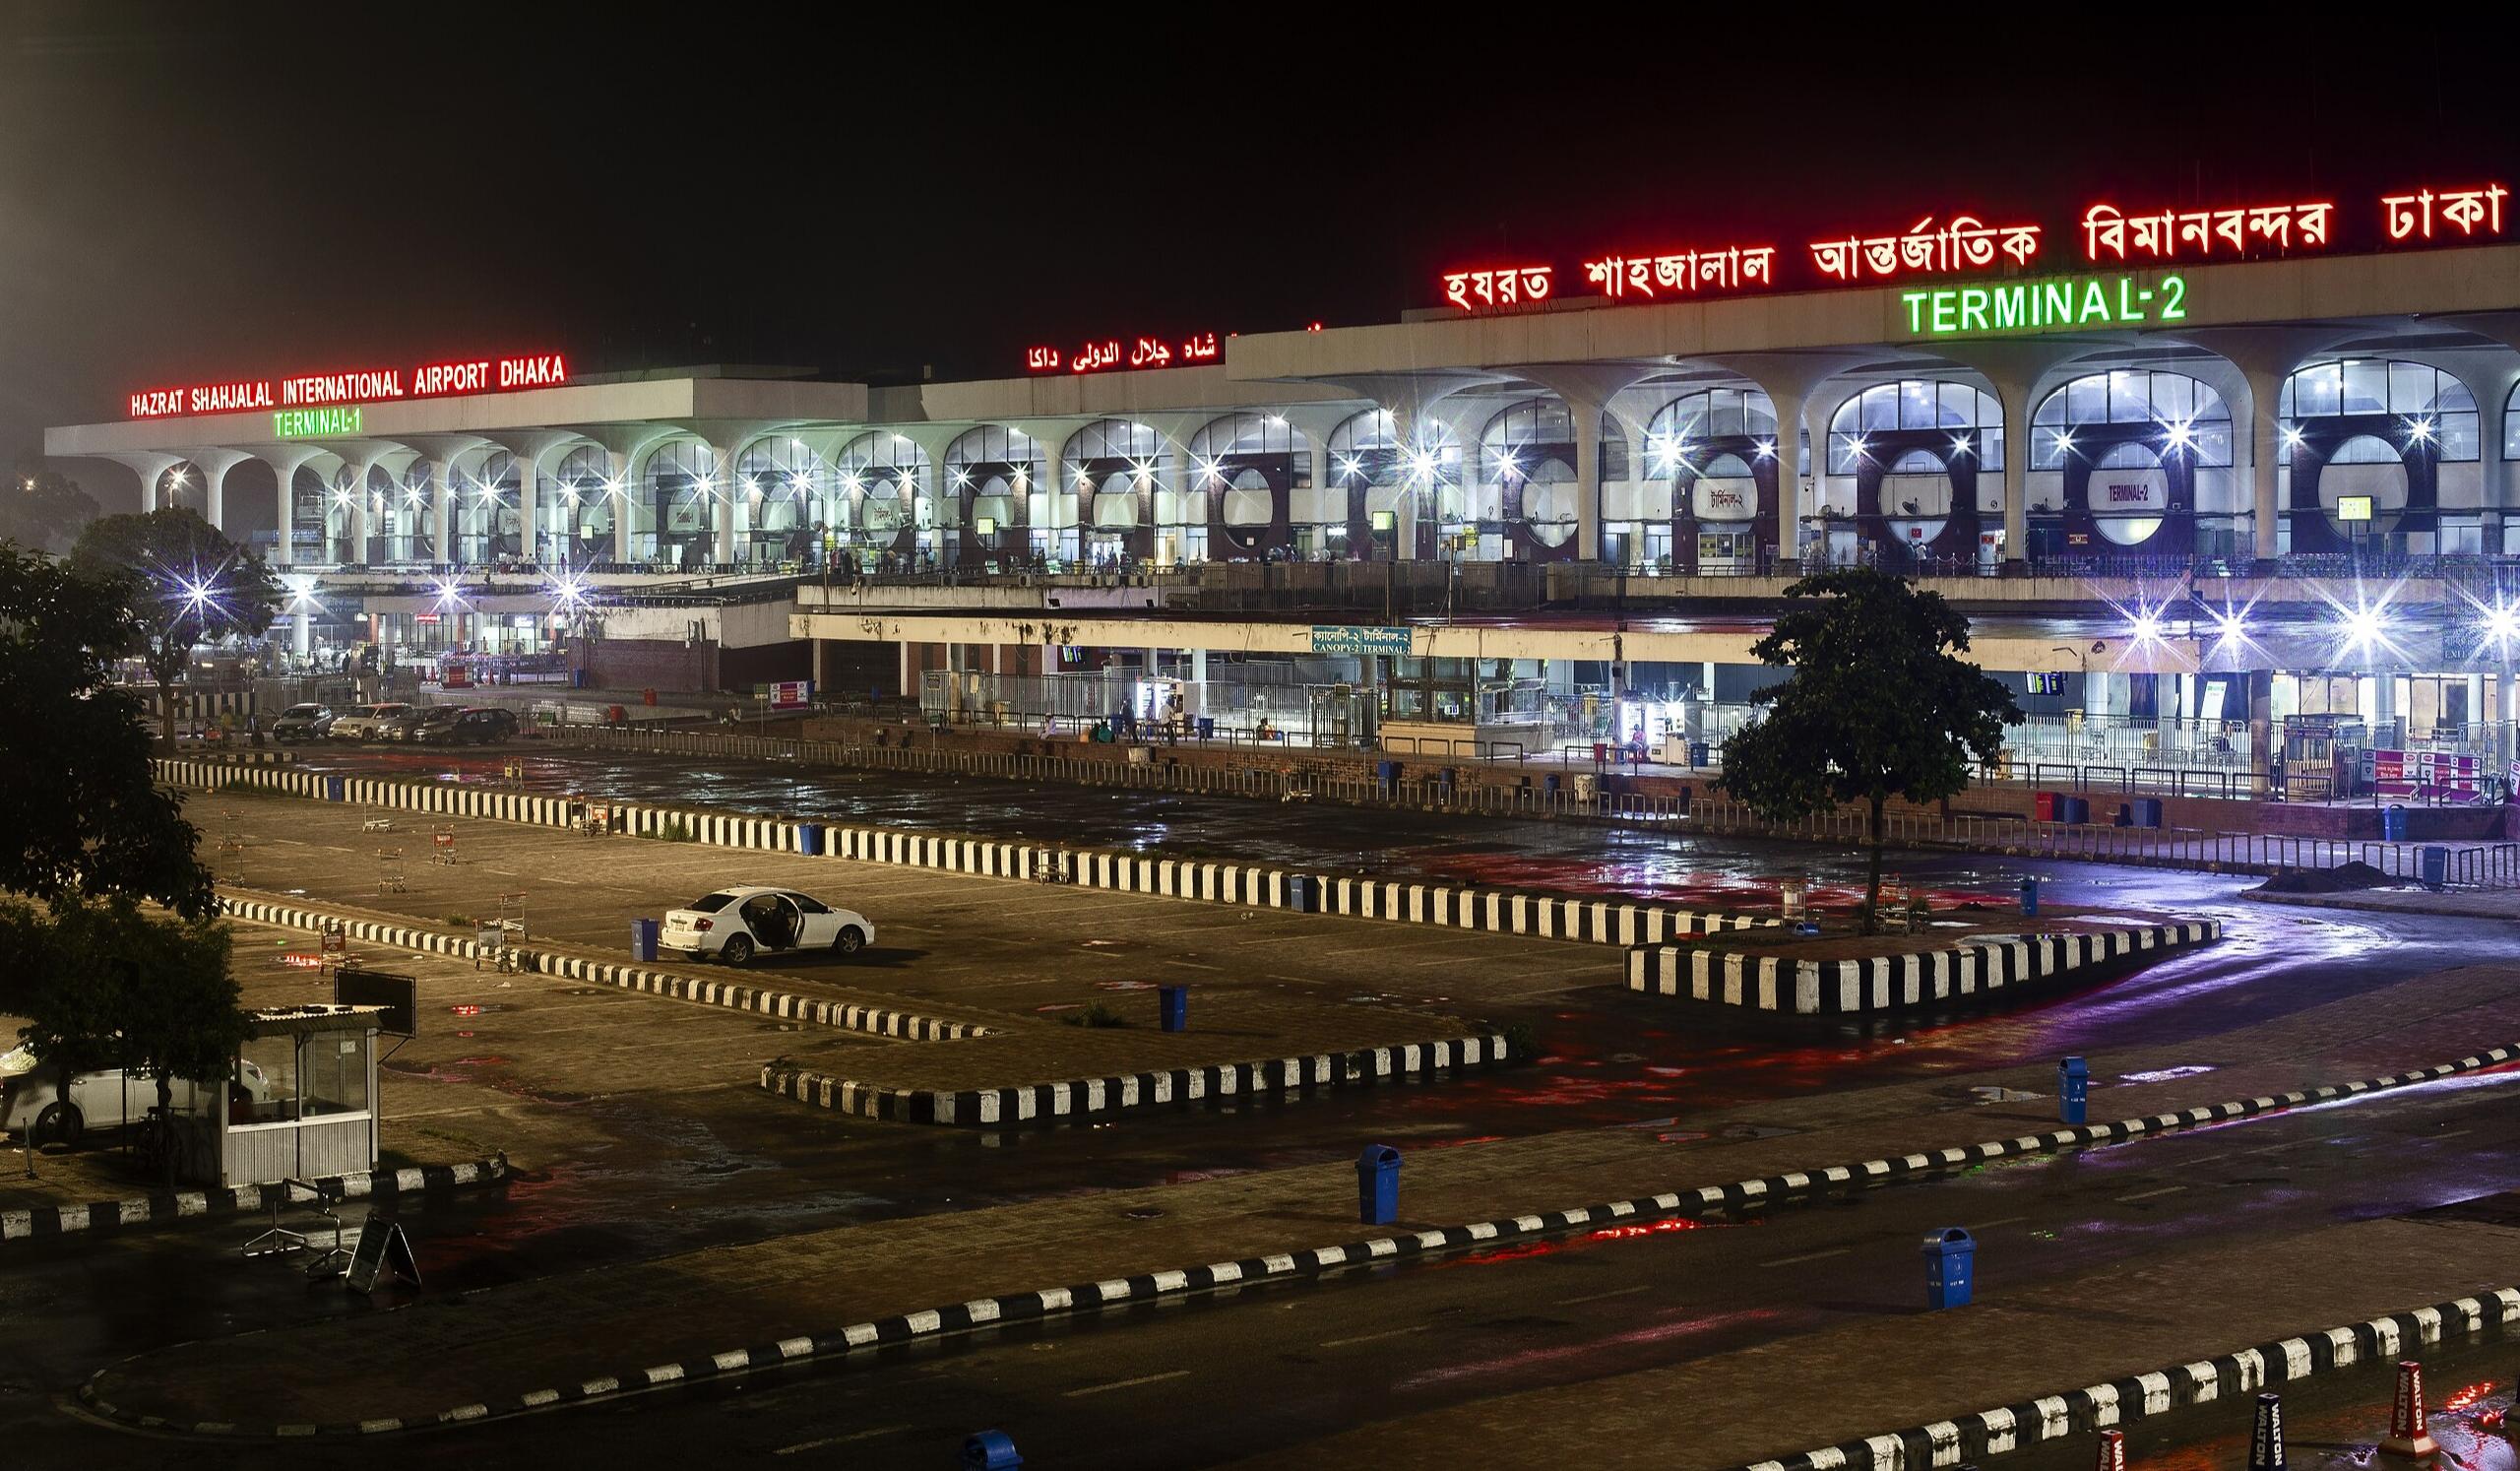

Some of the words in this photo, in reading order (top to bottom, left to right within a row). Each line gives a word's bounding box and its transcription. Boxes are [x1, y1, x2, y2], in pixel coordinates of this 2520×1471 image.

[1443, 267, 1552, 311] হযরত
[1584, 245, 1776, 297] শাহজালাল
[1809, 216, 2042, 282] আন্তর্জাতিক
[2082, 203, 2334, 261] বিমানবন্দর
[2381, 183, 2509, 239] ঢাকা
[1131, 338, 1170, 366] جلال
[1184, 333, 1216, 359] شاه
[131, 388, 184, 417] HAZRAT
[191, 381, 274, 412] SHAHJALAL
[283, 370, 404, 406] INTERNATIONAL
[413, 361, 489, 395] AIRPORT
[500, 354, 565, 388] DHAKA
[274, 407, 362, 437] TERMINAL-1
[2109, 483, 2149, 502] TERMINAL-2
[1312, 643, 1359, 653] CANOPY-2
[2413, 1370, 2424, 1432] WALTON
[2256, 1404, 2268, 1466] WALTON
[2271, 1403, 2283, 1466] WALTON
